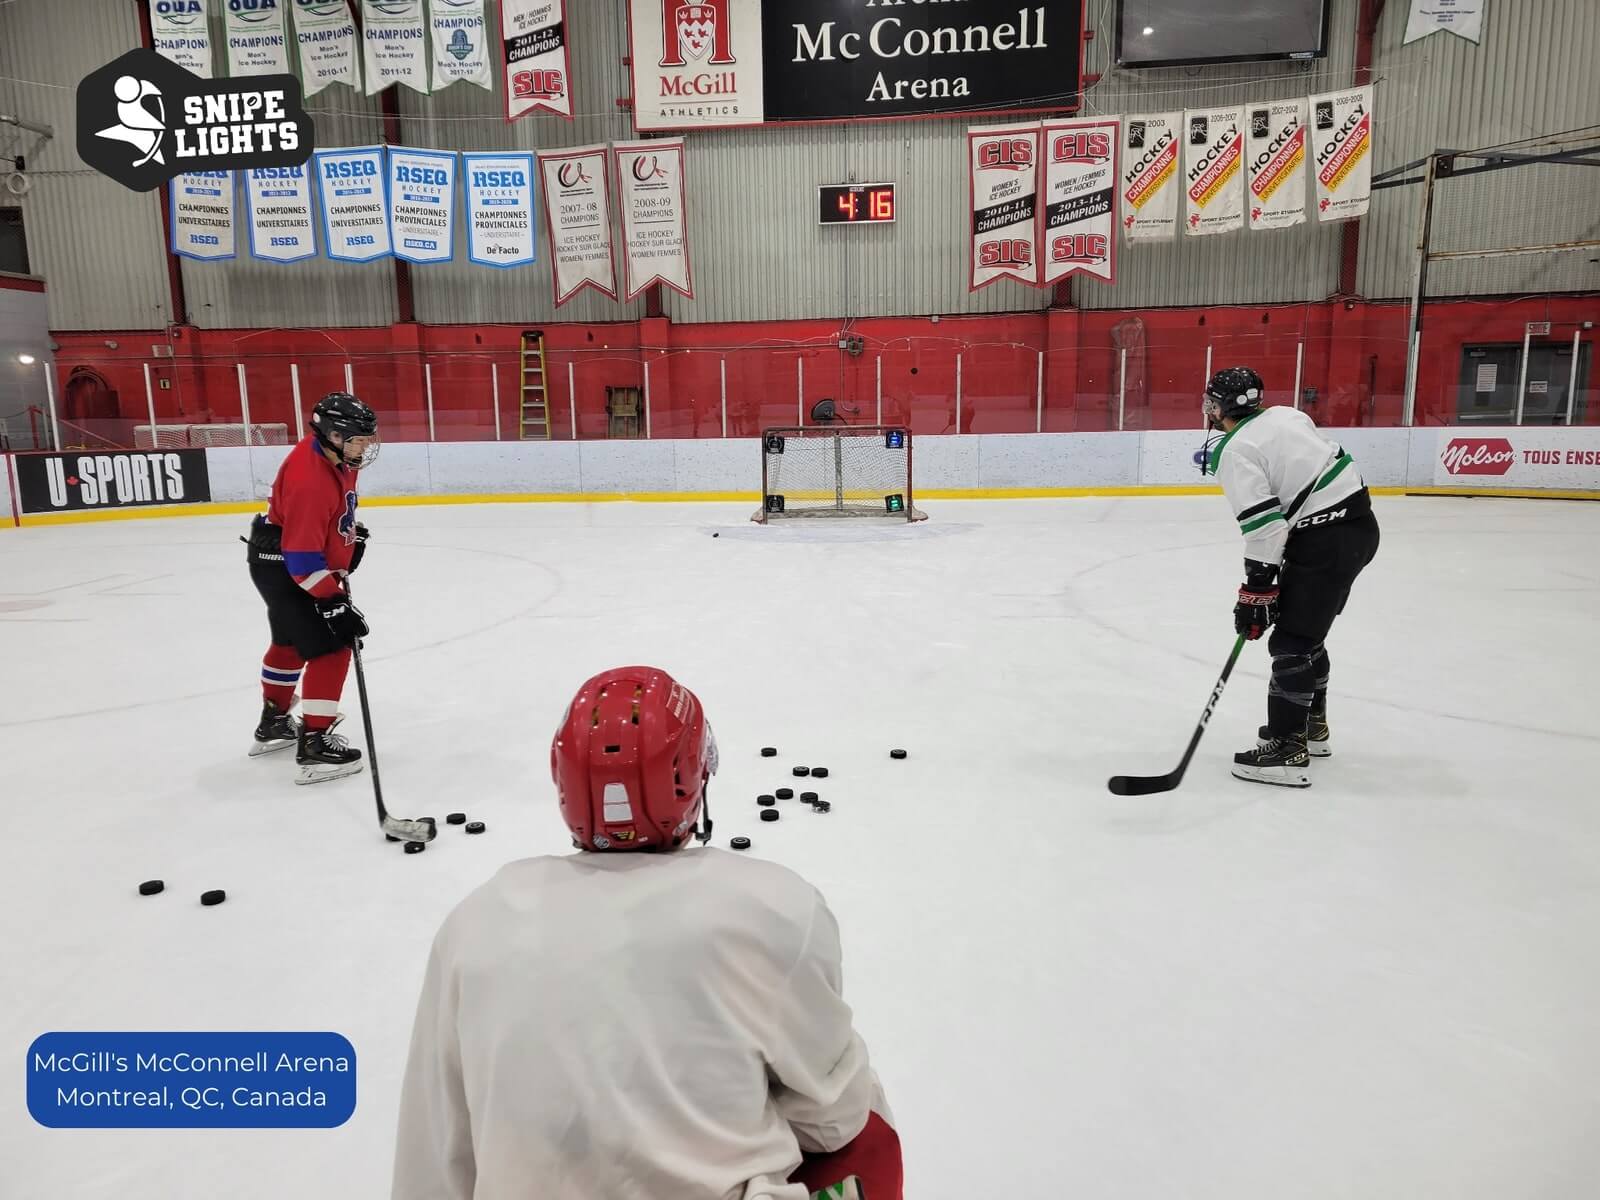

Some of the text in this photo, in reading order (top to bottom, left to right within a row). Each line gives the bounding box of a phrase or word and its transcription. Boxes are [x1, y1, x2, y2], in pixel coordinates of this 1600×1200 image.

[527, 14, 548, 27] HOCKEY
[298, 25, 354, 43] CHAMPIONS
[514, 28, 554, 47] 2011-12
[509, 35, 560, 61] CHAMPIONS
[317, 66, 348, 77] 2010-11
[380, 67, 412, 75] 2011-12
[511, 69, 563, 96] SIC
[658, 72, 738, 97] McGill
[865, 71, 970, 102] Arena
[659, 106, 739, 117] ATHLETICS
[1148, 119, 1165, 127] 2003
[1317, 103, 1364, 165] HOCKEY
[1053, 132, 1109, 161] CIS
[1250, 116, 1298, 174] HOCKEY
[978, 139, 1032, 168] CIS
[1125, 128, 1173, 183] HOCKEY
[1188, 123, 1237, 182] HOCKEY
[1321, 127, 1367, 182] CHAMPIONNES
[324, 160, 377, 179] RSEQ
[1191, 146, 1239, 198] CHAMPIONNES
[1253, 138, 1301, 192] CHAMPIONNES
[396, 166, 448, 186] RSEQ
[472, 171, 526, 188] RSEQ
[1054, 178, 1077, 190] WOMEN
[1081, 169, 1106, 183] FEMMES
[479, 189, 520, 197] HOCKEY
[991, 179, 1019, 193] WOMEN'S
[999, 185, 1022, 199] HOCKEY
[1073, 180, 1098, 193] HOCKEY
[178, 203, 229, 215] CHAMPIONNES
[330, 203, 382, 215] CHAMPIONNES
[634, 197, 671, 209] 2008-09
[839, 191, 891, 219] 4:16
[984, 200, 1025, 218] 2010-11
[1057, 194, 1102, 213] 2013-14
[256, 206, 307, 215] CHAMPIONNES
[395, 205, 448, 218] CHAMPIONNES
[474, 210, 528, 219] CHAMPIONNES
[633, 209, 674, 220] CHAMPIONS
[1051, 200, 1109, 227] CHAMPIONS
[178, 216, 231, 228] UNIVERSITAIRES
[256, 219, 309, 229] UNIVERSITAIRES
[330, 216, 384, 228] UNIVERSITAIRES
[394, 215, 447, 227] PROVINCIALES
[475, 220, 528, 230] PROVINCIALES
[560, 214, 600, 225] CHAMPIONS
[977, 207, 1032, 232] CHAMPIONS
[190, 234, 219, 246] RSEQ
[345, 235, 375, 246] RSEQ
[564, 233, 601, 244] ICE HOCKEY
[636, 229, 674, 239] ICE HOCKEY
[270, 236, 299, 247] RSEQ
[651, 239, 664, 247] SUR
[1052, 234, 1107, 262] SIC
[584, 252, 609, 261] FEMMES
[657, 249, 682, 258] FEMMES
[980, 239, 1031, 266] SIC
[1441, 444, 1516, 475] Molson
[1523, 450, 1561, 465] TOUS
[45, 453, 184, 507] U SPORTS
[1296, 508, 1348, 528] CCM
